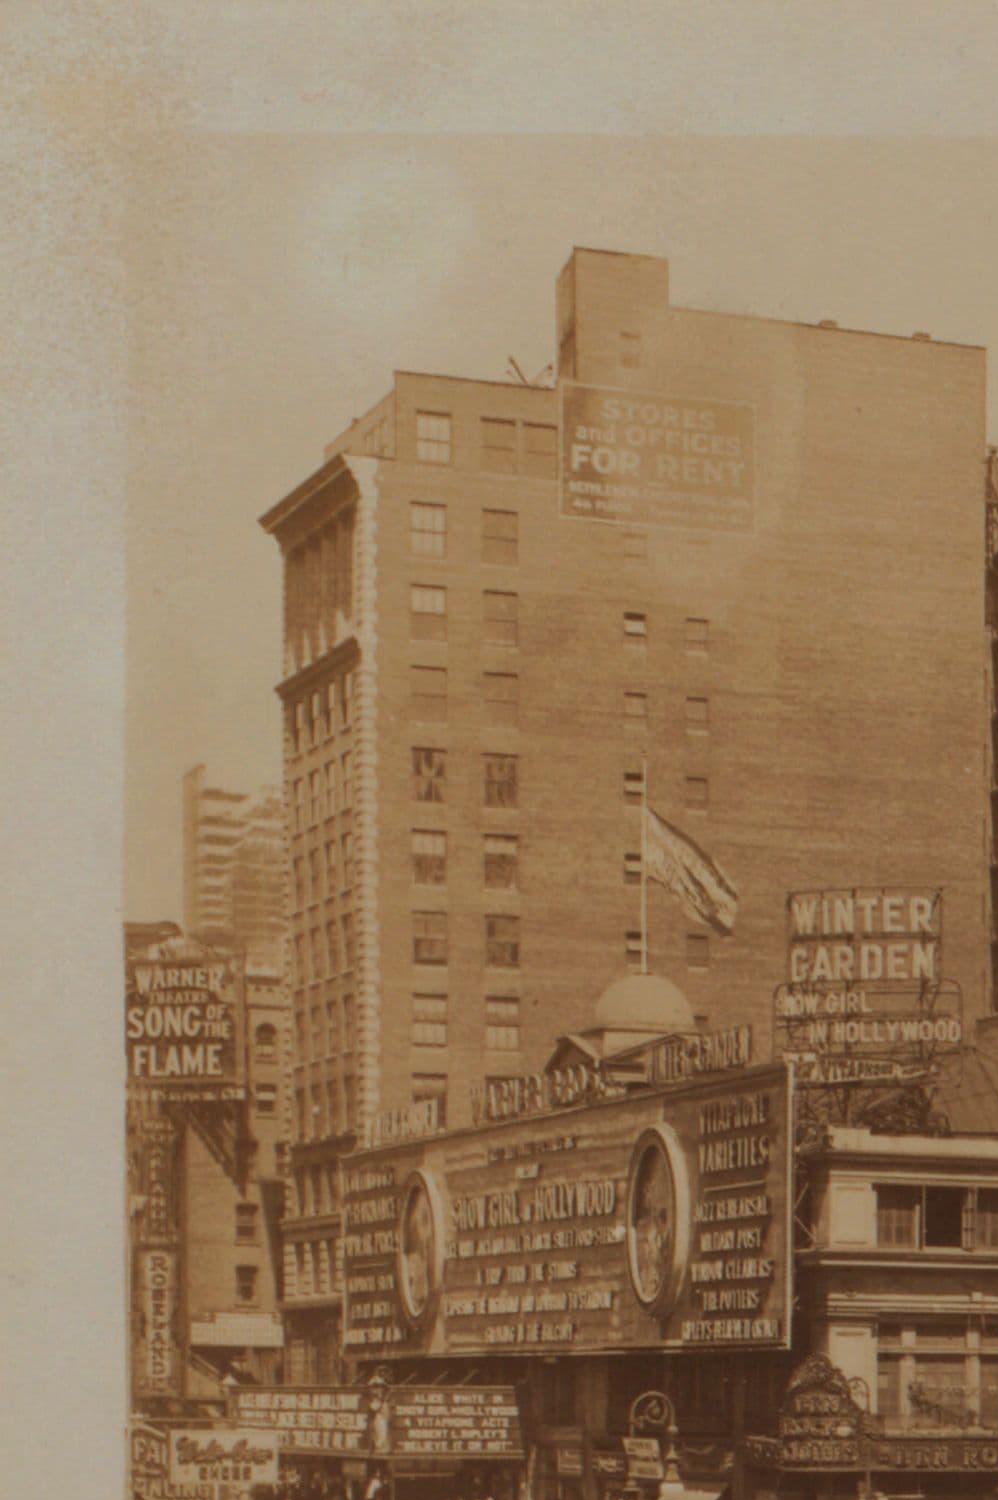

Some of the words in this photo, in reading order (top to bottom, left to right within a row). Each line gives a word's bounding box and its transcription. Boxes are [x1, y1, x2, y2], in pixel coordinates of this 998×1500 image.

[602, 399, 716, 430] STORES
[624, 426, 741, 456] OFFICES
[571, 443, 641, 477] FOR
[655, 453, 744, 486] RENT
[791, 895, 933, 934] WINTER
[790, 942, 935, 982] GARDEN
[134, 963, 225, 995] WARNER
[825, 990, 873, 1014] GIRL
[130, 1005, 200, 1039] SONG
[205, 1003, 227, 1020] OF
[205, 1019, 231, 1039] THE
[808, 1022, 827, 1044] IN
[833, 1020, 962, 1043] HOLLYWOOD
[133, 1044, 223, 1077] FLAME
[699, 1135, 769, 1174] VARIETIES
[488, 1190, 520, 1225] GIRL
[534, 1180, 615, 1222] HOLLYWOOD
